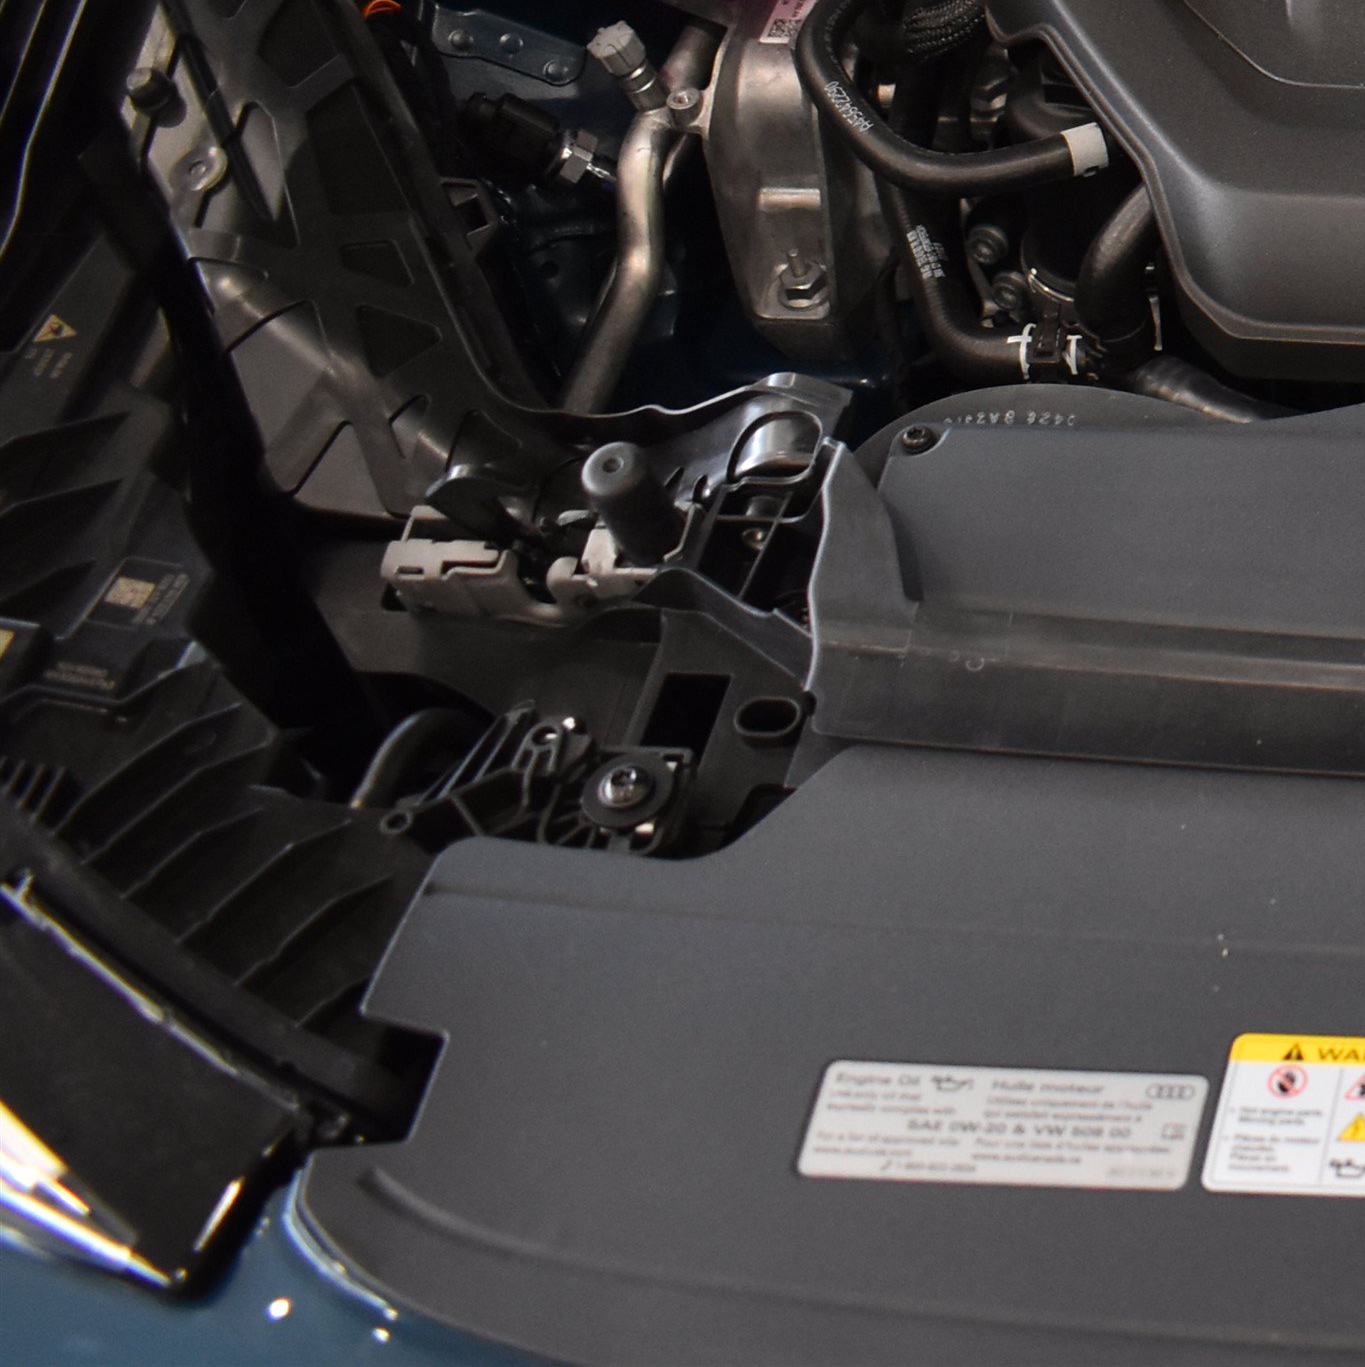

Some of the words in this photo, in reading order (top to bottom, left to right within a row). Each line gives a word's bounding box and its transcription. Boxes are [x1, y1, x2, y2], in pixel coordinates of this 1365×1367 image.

[836, 1072, 891, 1086] Engine
[899, 1074, 921, 1085] Oil
[993, 1079, 1034, 1091] Huile
[1039, 1081, 1104, 1093] moteur
[908, 1118, 942, 1131] SAE
[1012, 1122, 1025, 1134] &
[1033, 1123, 1067, 1136] VW
